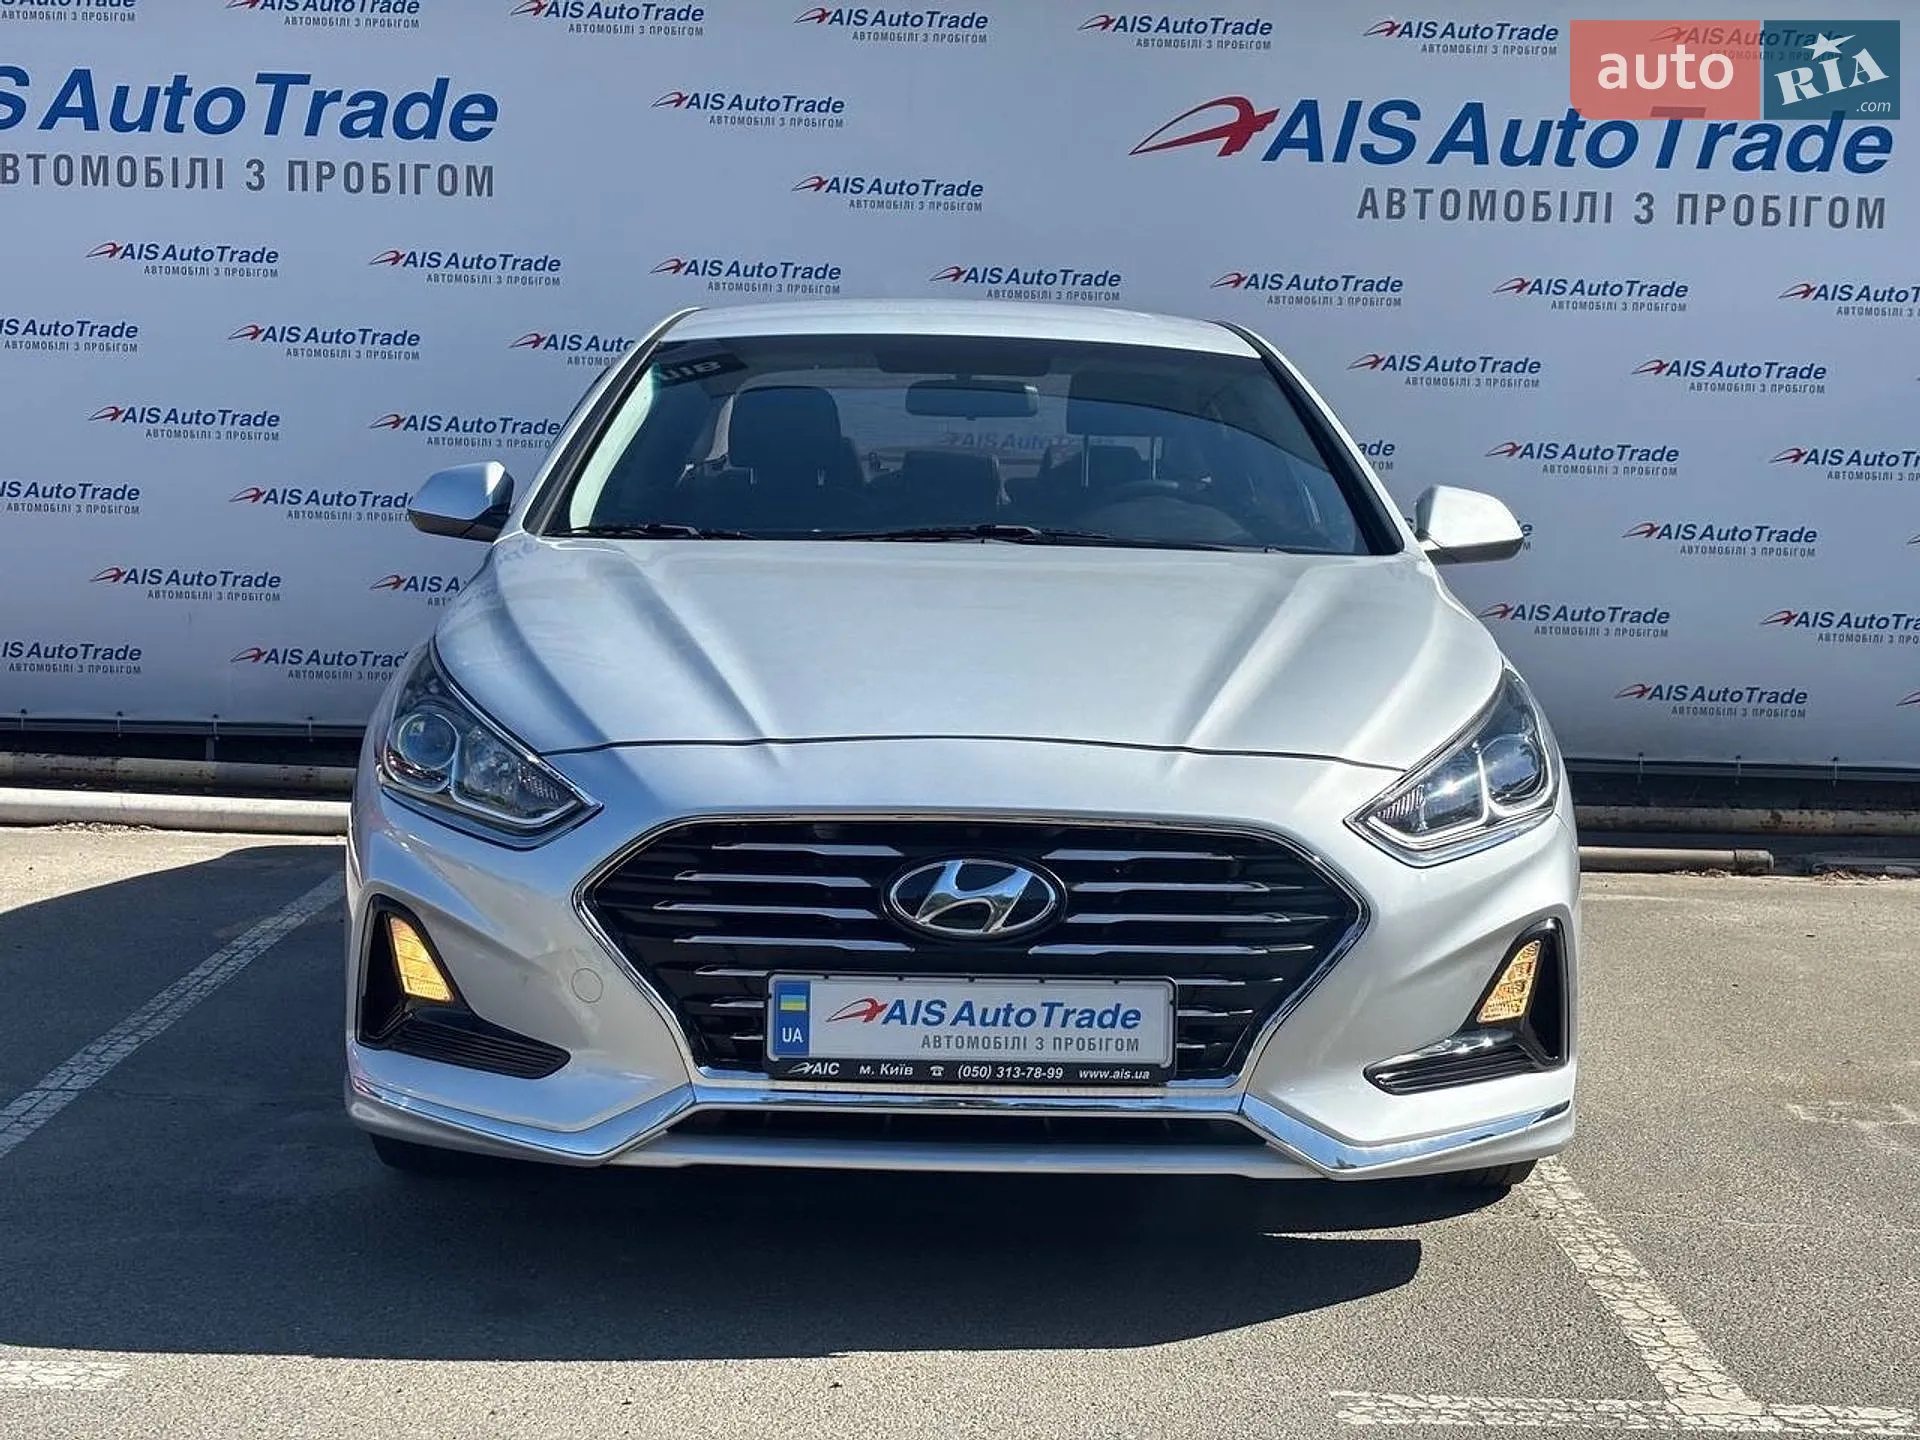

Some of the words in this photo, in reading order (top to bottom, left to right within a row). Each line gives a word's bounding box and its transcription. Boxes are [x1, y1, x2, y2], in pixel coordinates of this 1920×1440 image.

[262, 0, 302, 11] AIS
[546, 0, 584, 19] AIS
[588, 0, 704, 22] AutoTrade
[829, 8, 868, 26] AIS
[870, 9, 988, 30] AutoTrade
[1112, 15, 1152, 33] AIS
[1153, 16, 1273, 35] AutoTrade
[1397, 21, 1438, 39] AIS
[1439, 22, 1559, 41] AutoTrade
[38, 68, 499, 142] AutoTrade
[686, 93, 725, 110] AIS
[728, 94, 845, 114] AutoTrade
[1262, 99, 1421, 165] AIS
[1428, 102, 1893, 174] AutoTrade
[246, 158, 265, 191] З
[288, 160, 494, 197] ПРОБІГОМ
[825, 177, 865, 194] AIS
[866, 178, 983, 197] AutoTrade
[1357, 187, 1613, 223] АВТОМОБІЛІ
[1634, 192, 1655, 224] З
[1676, 193, 1886, 229] ПРОБІГОМ
[120, 243, 160, 260] AIS
[161, 244, 279, 264] AutoTrade
[402, 251, 442, 268] AIS
[444, 252, 561, 273] AutoTrade
[683, 259, 723, 277] AIS
[724, 260, 841, 280] AutoTrade
[963, 267, 1003, 284] AIS
[1004, 268, 1121, 288] AutoTrade
[1244, 273, 1284, 290] AIS
[1285, 274, 1403, 292] AutoTrade
[1527, 278, 1568, 295] AIS
[1569, 279, 1688, 299] AutoTrade
[1813, 284, 1854, 301] AIS
[21, 319, 139, 338] AutoTrade
[262, 326, 301, 343] AIS
[303, 327, 420, 346] AutoTrade
[543, 334, 582, 351] AIS
[1382, 355, 1422, 371] AIS
[1423, 356, 1541, 375] AutoTrade
[1665, 360, 1706, 377] AIS
[1707, 361, 1827, 380] AutoTrade
[121, 407, 161, 424] AIS
[163, 408, 280, 427] AutoTrade
[402, 415, 443, 432] AIS
[444, 415, 561, 435] AutoTrade
[1518, 443, 1559, 460] AIS
[1561, 444, 1679, 462] AutoTrade
[1803, 448, 1844, 466] AIS
[23, 482, 140, 500] AutoTrade
[263, 488, 303, 505] AIS
[305, 489, 412, 508] AutoTrad
[1656, 524, 1697, 540] AIS
[1698, 524, 1817, 543] AutoTrade
[123, 568, 163, 585] AIS
[165, 568, 281, 588] AutoTrade
[402, 576, 443, 592] AIS
[1511, 604, 1551, 621] AIS
[1552, 605, 1670, 624] AutoTrade
[1794, 611, 1835, 628] AIS
[26, 642, 142, 661] AutoTrade
[263, 648, 303, 665] AIS
[1647, 685, 1688, 701] AIS
[1689, 686, 1807, 705] AutoTrade
[882, 999, 946, 1026] AIS
[949, 1000, 1141, 1029] AutoTrade
[782, 1028, 803, 1043] UA
[921, 1035, 1027, 1050] АВТОМОБІЛІ
[1035, 1037, 1044, 1050] З
[1052, 1038, 1139, 1052] ПРОБІГОМ
[880, 1063, 914, 1075] Київ
[958, 1064, 992, 1079] (050)
[996, 1066, 1063, 1079] 313-78-99
[1079, 1069, 1150, 1079] www.ais.ua
